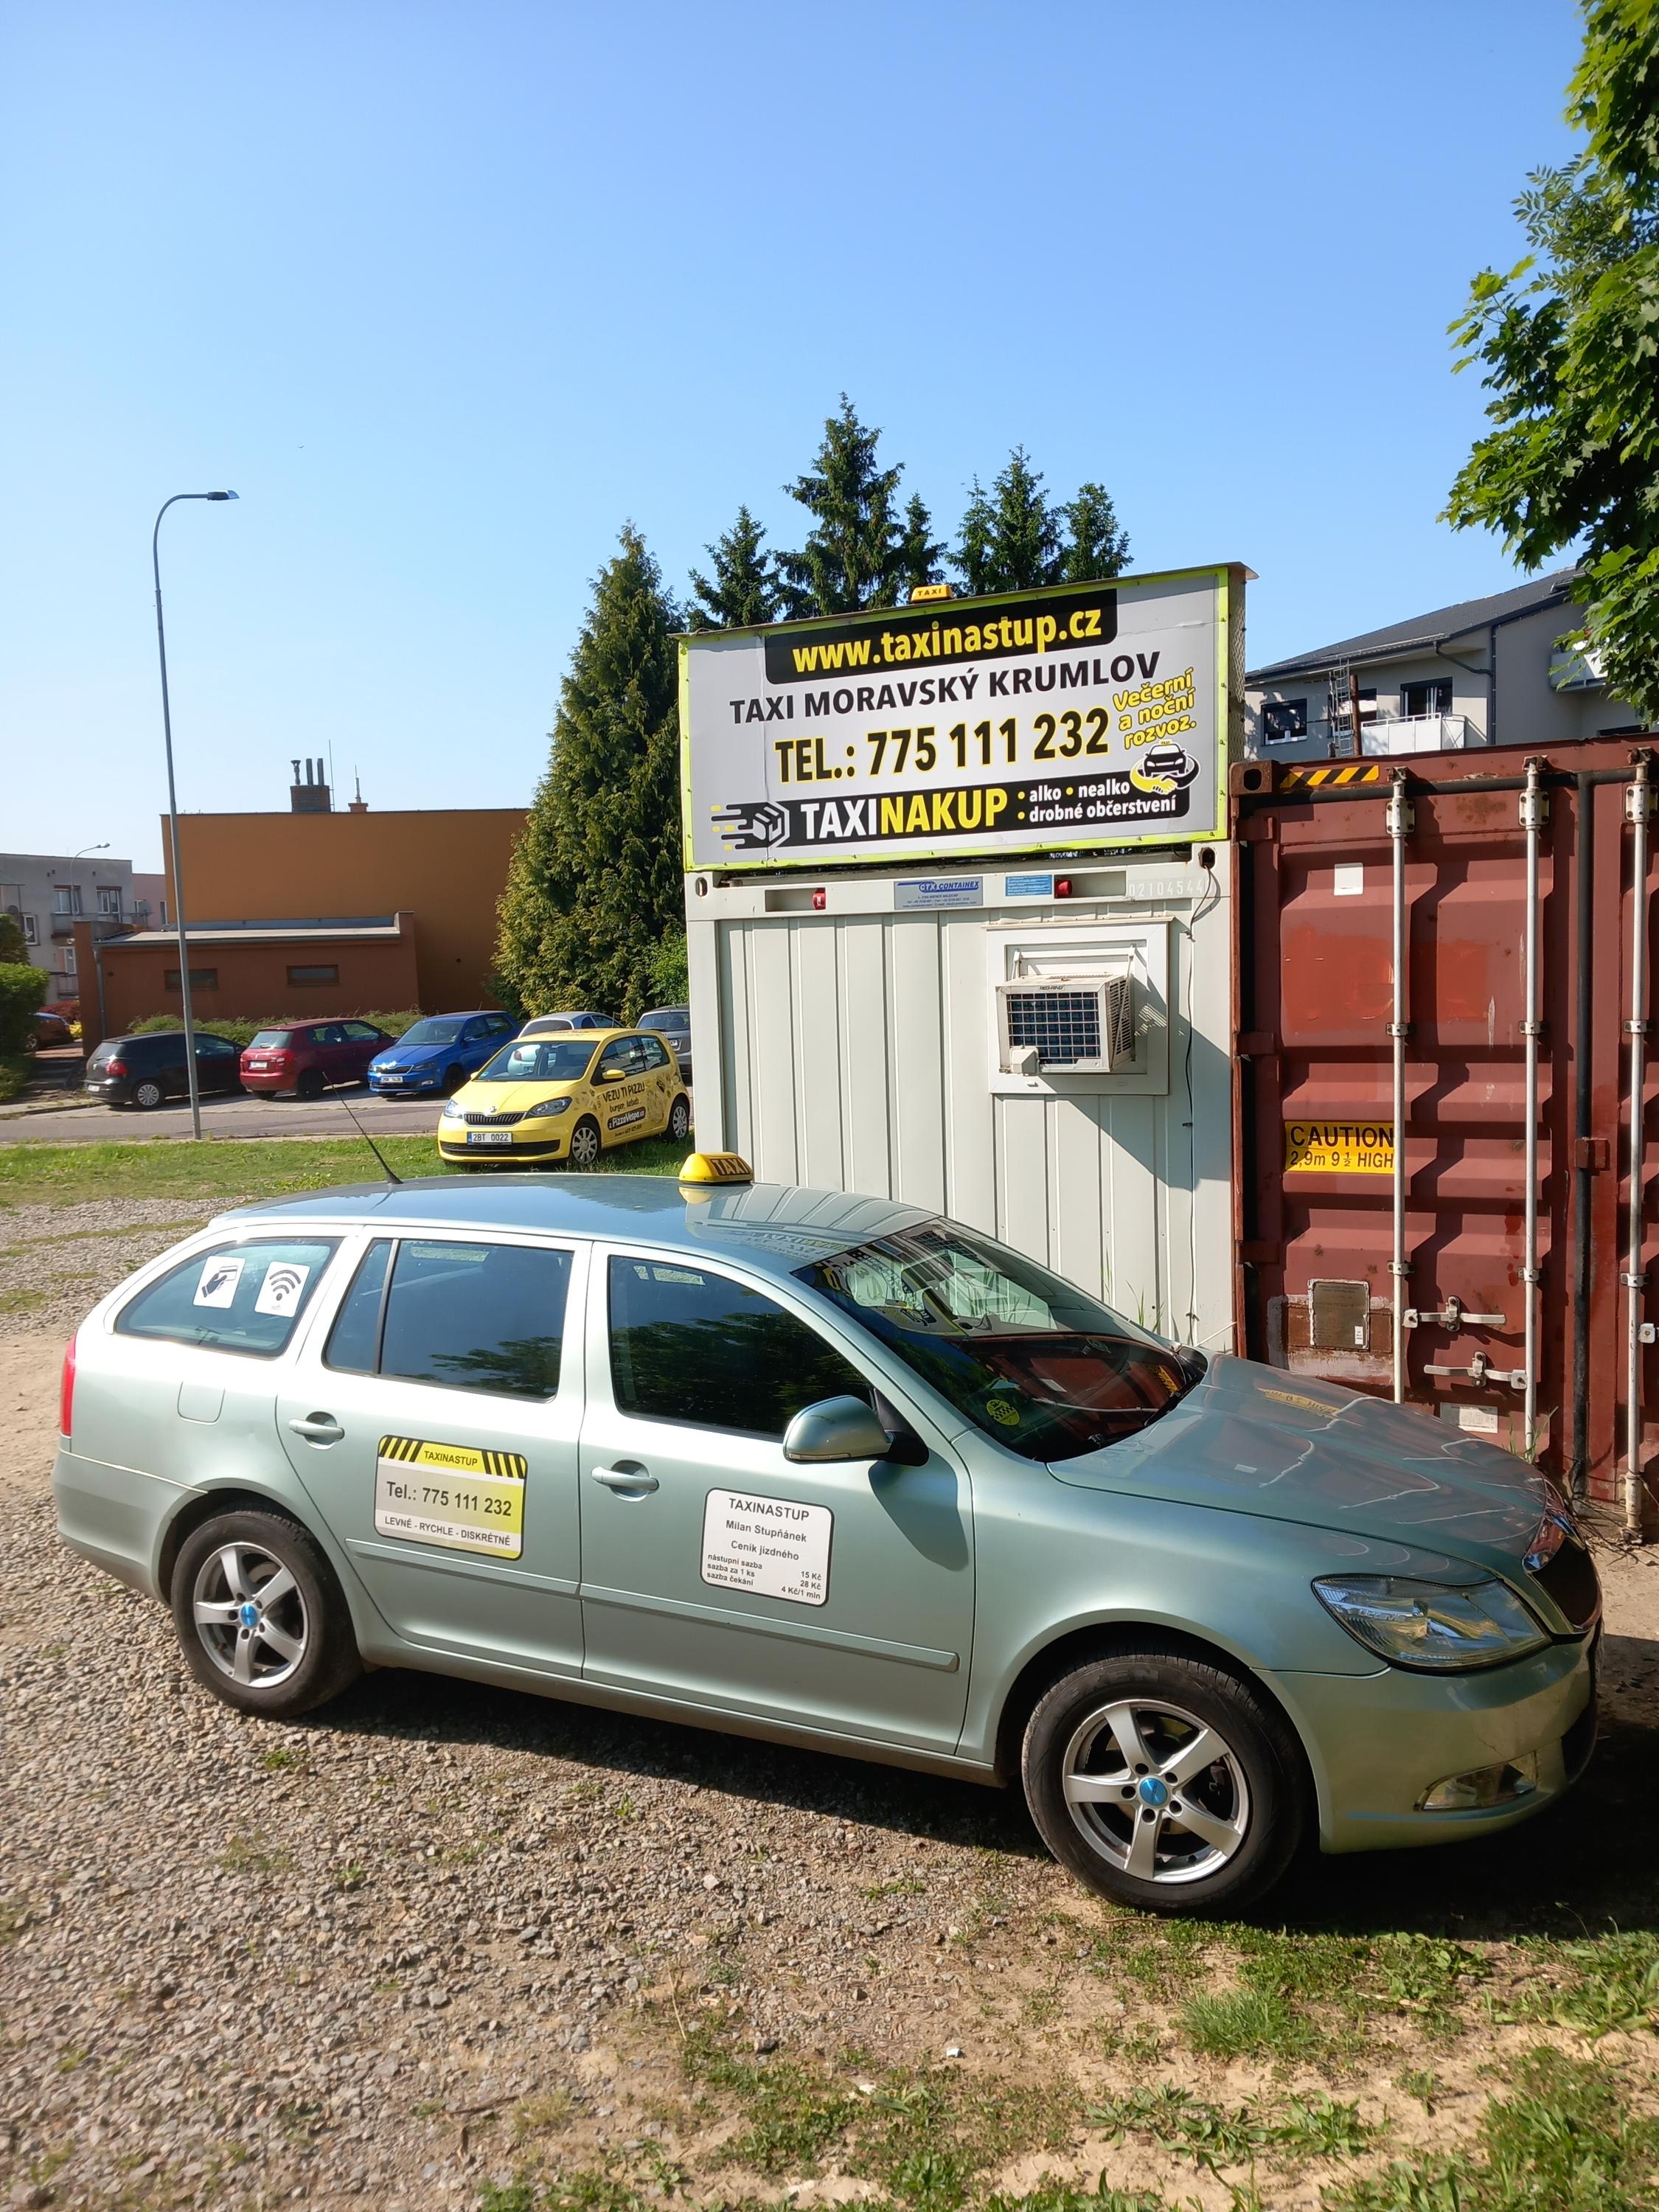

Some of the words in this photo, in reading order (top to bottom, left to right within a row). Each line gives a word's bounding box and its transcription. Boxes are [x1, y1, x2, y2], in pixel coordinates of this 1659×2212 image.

[792, 610, 1102, 672] www.taxinastup.cz
[730, 695, 793, 724] TAXI
[805, 667, 979, 716] MORAVSKÝ
[990, 651, 1161, 697] KRUMLOV
[1113, 667, 1194, 712] Večerní
[1119, 714, 1132, 731] a
[1138, 687, 1196, 725] noční
[1124, 714, 1197, 750] rozvoz.
[775, 739, 855, 783] TEL.:
[868, 726, 937, 776] 775
[950, 718, 1017, 768] 111
[1033, 708, 1109, 761] 232
[1029, 783, 1062, 803] alko
[1079, 779, 1130, 798] nealko
[801, 788, 1008, 839] TAXINAKUP
[1029, 804, 1082, 823] drobné
[1087, 795, 1177, 818] občerstvení
[939, 880, 979, 891] CONTAINEX
[627, 1082, 645, 1096] PIZZU
[1290, 1126, 1394, 1148] CAUTION
[710, 1158, 750, 1175] TAXI
[1290, 1150, 1325, 1168] 2,9m
[1358, 1152, 1394, 1168] HIGH
[424, 1450, 478, 1467] TAXINASTUP
[386, 1481, 417, 1501] Tel.:
[422, 1487, 449, 1506] 775
[454, 1493, 478, 1511] 111
[484, 1498, 512, 1516] 232
[729, 1498, 810, 1521] TAXINASTUP
[385, 1516, 412, 1528] LEVNÉ
[420, 1523, 453, 1536] RYCHLE
[726, 1520, 751, 1533] Milan
[754, 1525, 807, 1543] Stupňánek
[731, 1540, 757, 1553] Ceník
[759, 1544, 799, 1560] jízdného
[707, 1562, 728, 1572] sazba
[811, 1581, 821, 1590] Kč
[708, 1554, 740, 1565] nástupní
[741, 1559, 762, 1570] sazba
[801, 1571, 809, 1579] 15
[811, 1571, 821, 1581] Kč
[706, 1571, 728, 1582] sazba
[729, 1575, 754, 1586] čekání
[787, 1587, 804, 1596] Kč/1
